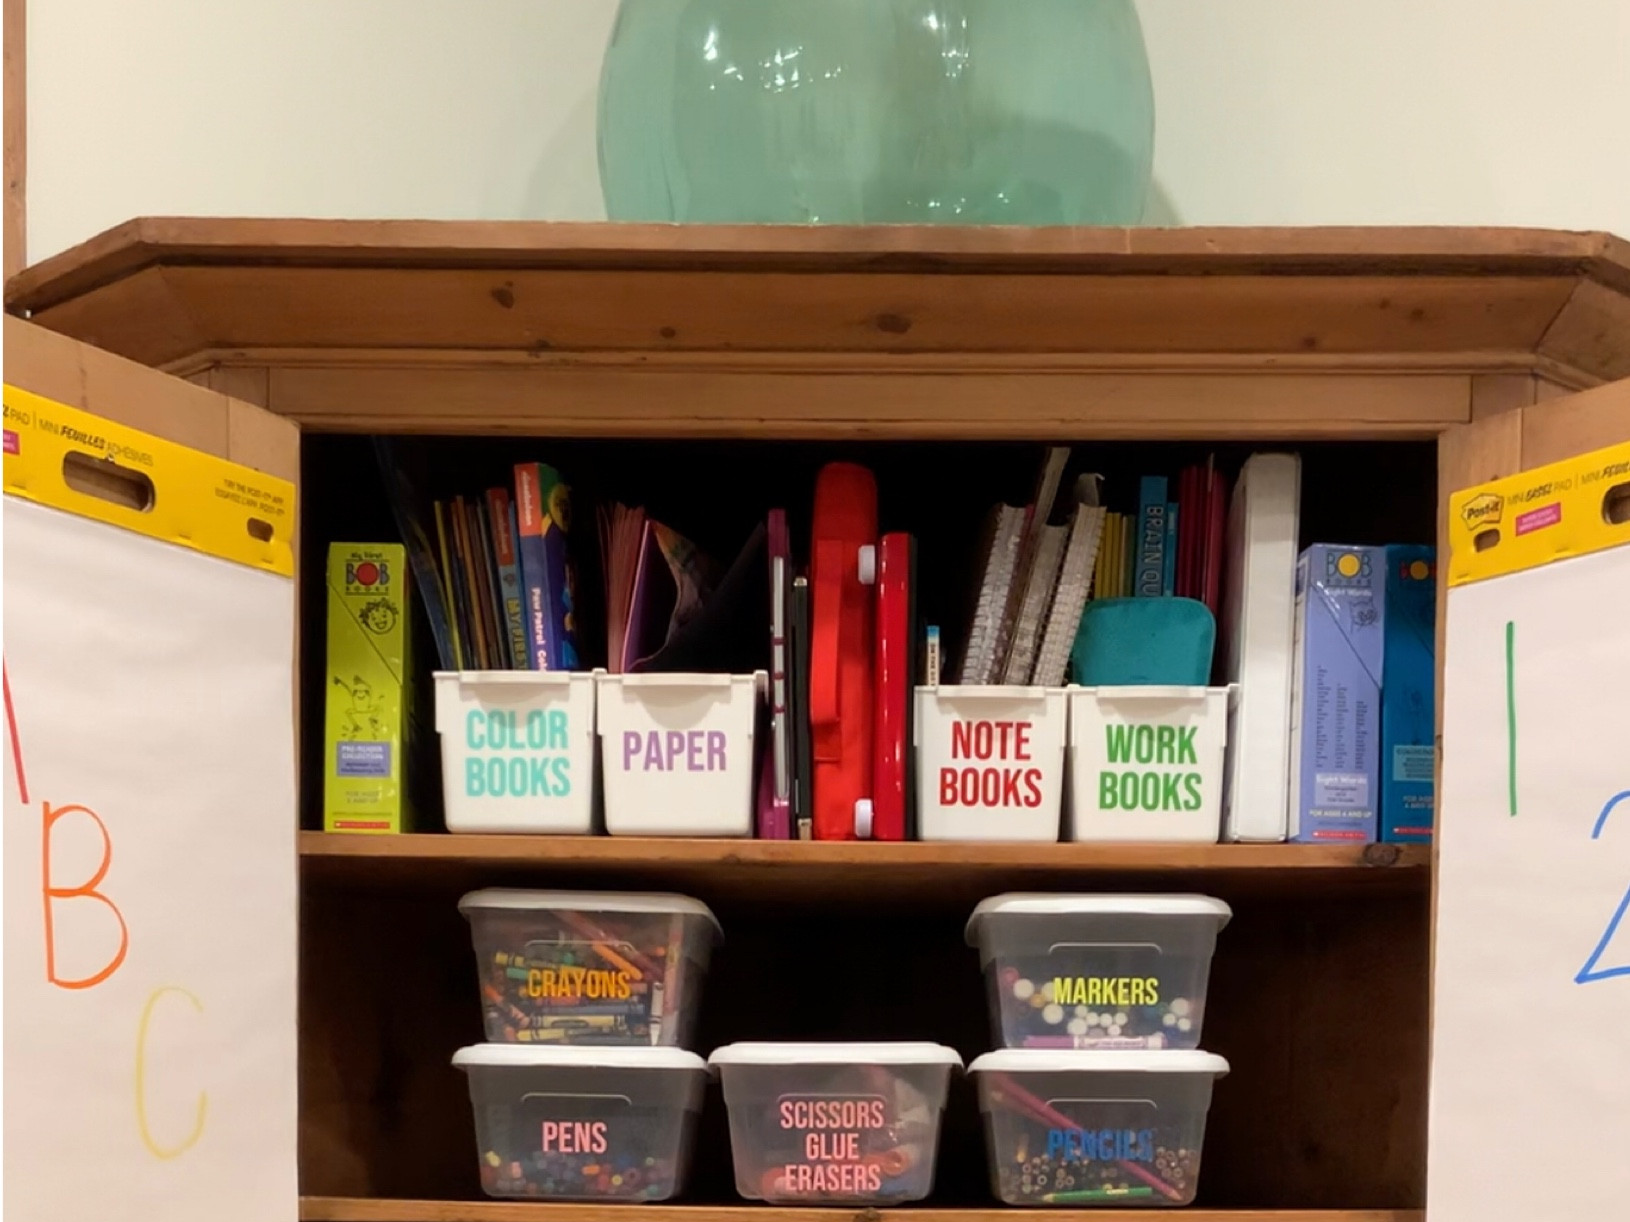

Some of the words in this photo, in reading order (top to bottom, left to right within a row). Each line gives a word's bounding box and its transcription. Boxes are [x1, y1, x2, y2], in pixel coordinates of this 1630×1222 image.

[10, 410, 30, 426] PAD
[60, 425, 106, 450] FEUILLES
[1466, 500, 1500, 520] Post-it
[1143, 505, 1164, 565] BRAIN
[346, 562, 390, 586] BOB
[1327, 552, 1373, 579] BOB
[534, 611, 545, 645] Patrol
[465, 708, 569, 749] COLOR
[951, 720, 1032, 762] NOTE
[1105, 724, 1199, 766] WORK
[623, 730, 727, 771] PAPER
[465, 756, 571, 797] BOOKS
[939, 766, 1043, 808] BOOKS
[1098, 771, 1203, 812] BOOKS
[43, 801, 128, 989] B
[527, 967, 631, 1000] CRAYONS
[1053, 976, 1160, 1006] MARKERS
[136, 985, 208, 1160] C
[779, 1099, 885, 1129] SCISSORS
[542, 1121, 608, 1154] PENS
[805, 1132, 860, 1162] GLUE
[1045, 1128, 1155, 1162] PENCILS
[784, 1163, 882, 1192] ERASERS
